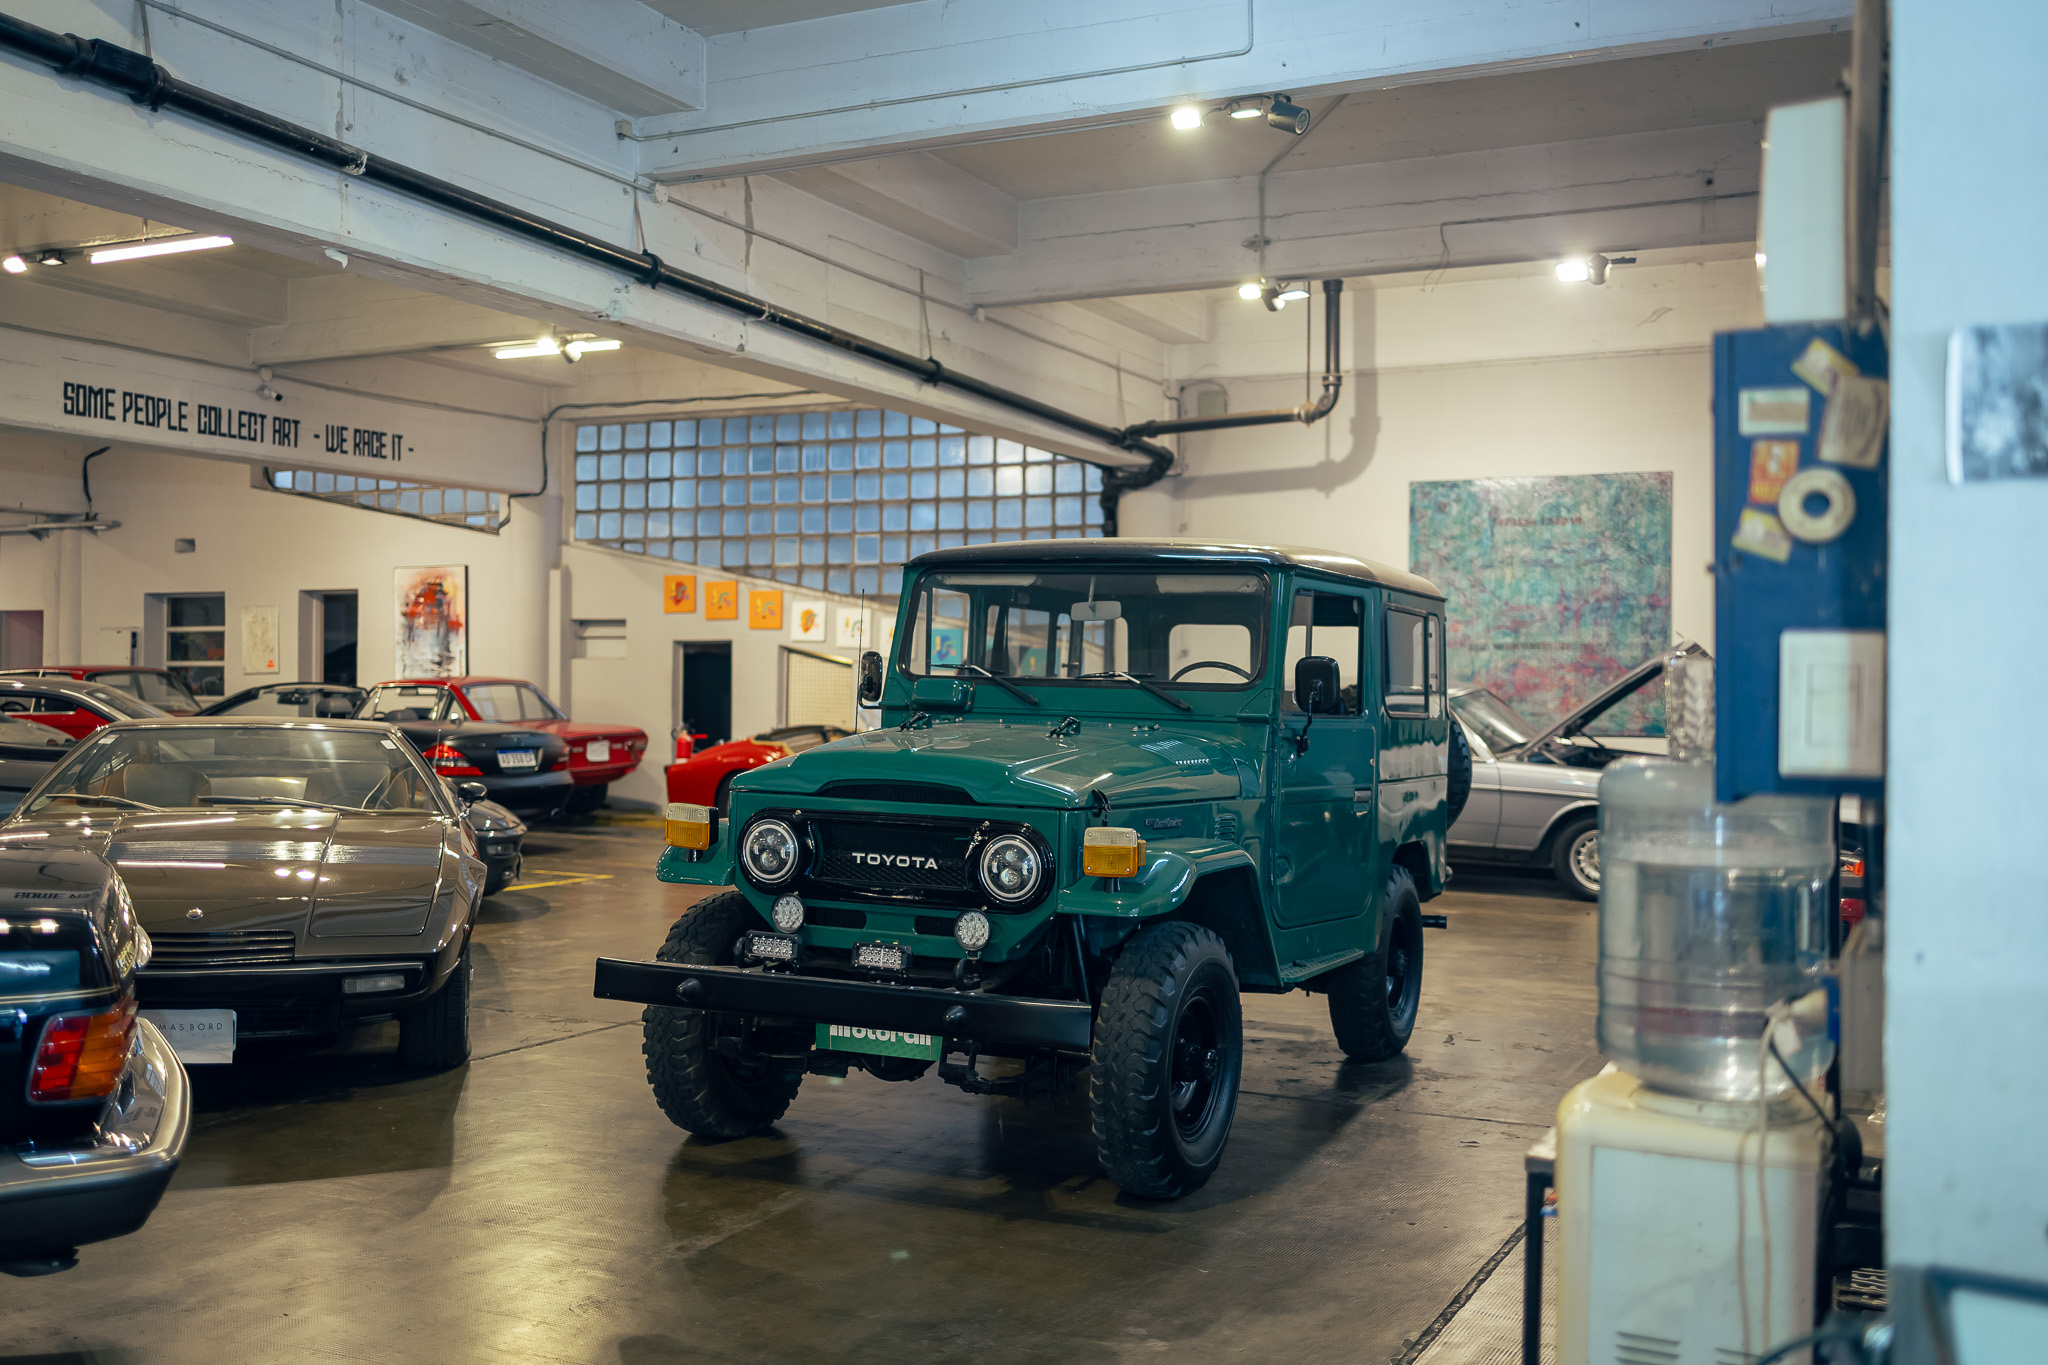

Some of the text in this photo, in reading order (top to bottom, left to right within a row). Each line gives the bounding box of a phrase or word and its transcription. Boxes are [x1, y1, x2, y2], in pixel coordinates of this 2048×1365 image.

[63, 381, 116, 421] SOME
[122, 391, 188, 432] PEOPLE
[197, 404, 267, 443] COLLECT
[272, 416, 301, 449] ART
[325, 424, 349, 454] WE
[353, 428, 388, 459] RACE
[391, 434, 404, 461] IT
[852, 852, 939, 870] TOYOTA
[159, 1022, 224, 1031] MAS BORD
